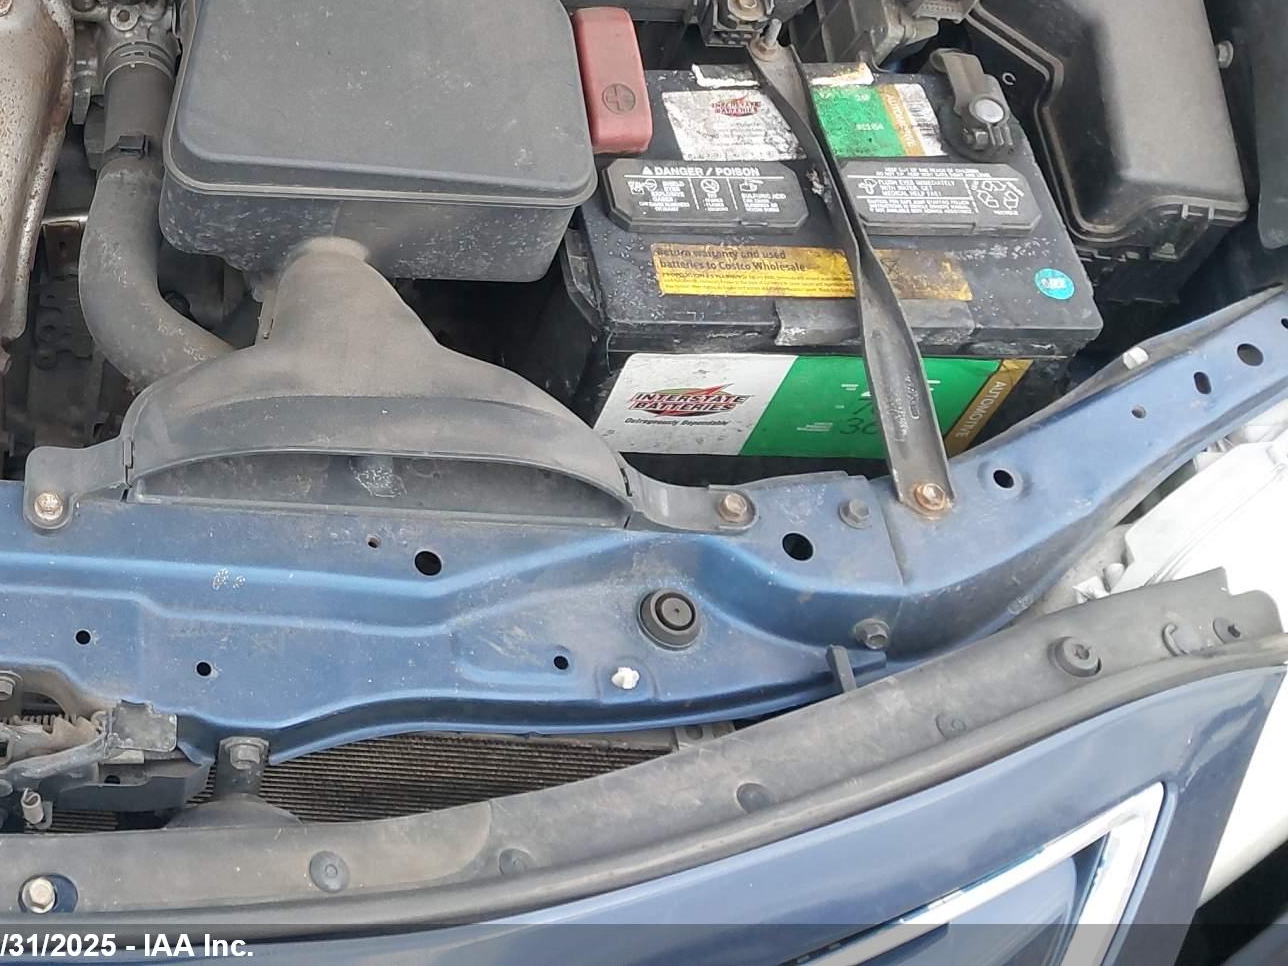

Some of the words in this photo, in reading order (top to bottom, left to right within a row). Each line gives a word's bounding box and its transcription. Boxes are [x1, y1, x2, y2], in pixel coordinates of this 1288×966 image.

[654, 166, 704, 176] DANGER
[715, 167, 761, 177] POISON
[740, 249, 760, 259] and
[762, 250, 787, 260] used
[660, 260, 706, 270] batteries
[707, 261, 717, 270] to
[718, 261, 752, 271] Costco
[753, 261, 806, 273] Wholesale
[633, 392, 747, 404] INTERSTATE
[633, 402, 735, 412] BATTERIES
[954, 380, 1007, 438] AUTOMOTIVE
